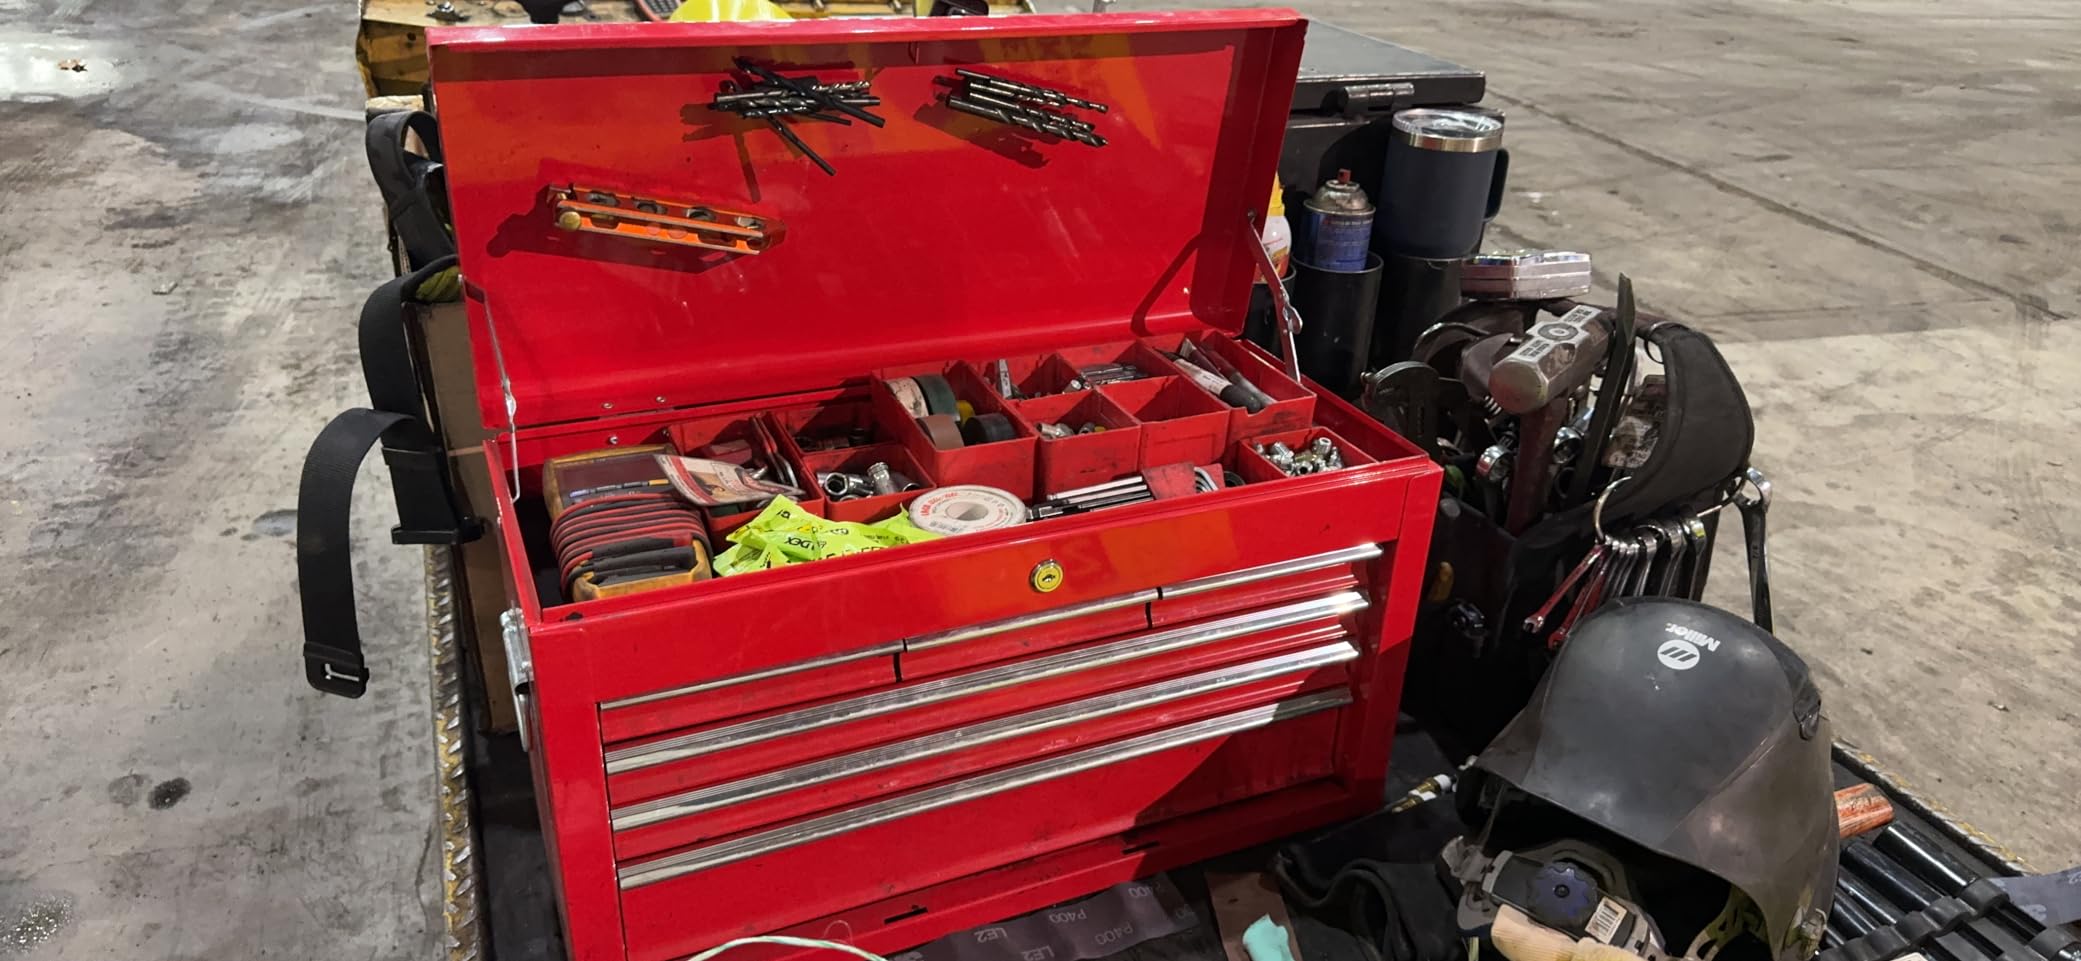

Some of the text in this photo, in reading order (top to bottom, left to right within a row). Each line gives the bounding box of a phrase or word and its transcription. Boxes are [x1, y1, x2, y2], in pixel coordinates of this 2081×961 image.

[1048, 908, 1087, 924] P400
[974, 927, 1007, 943] LE2
[1094, 921, 1134, 945] P400
[1021, 946, 1055, 961] LE2
